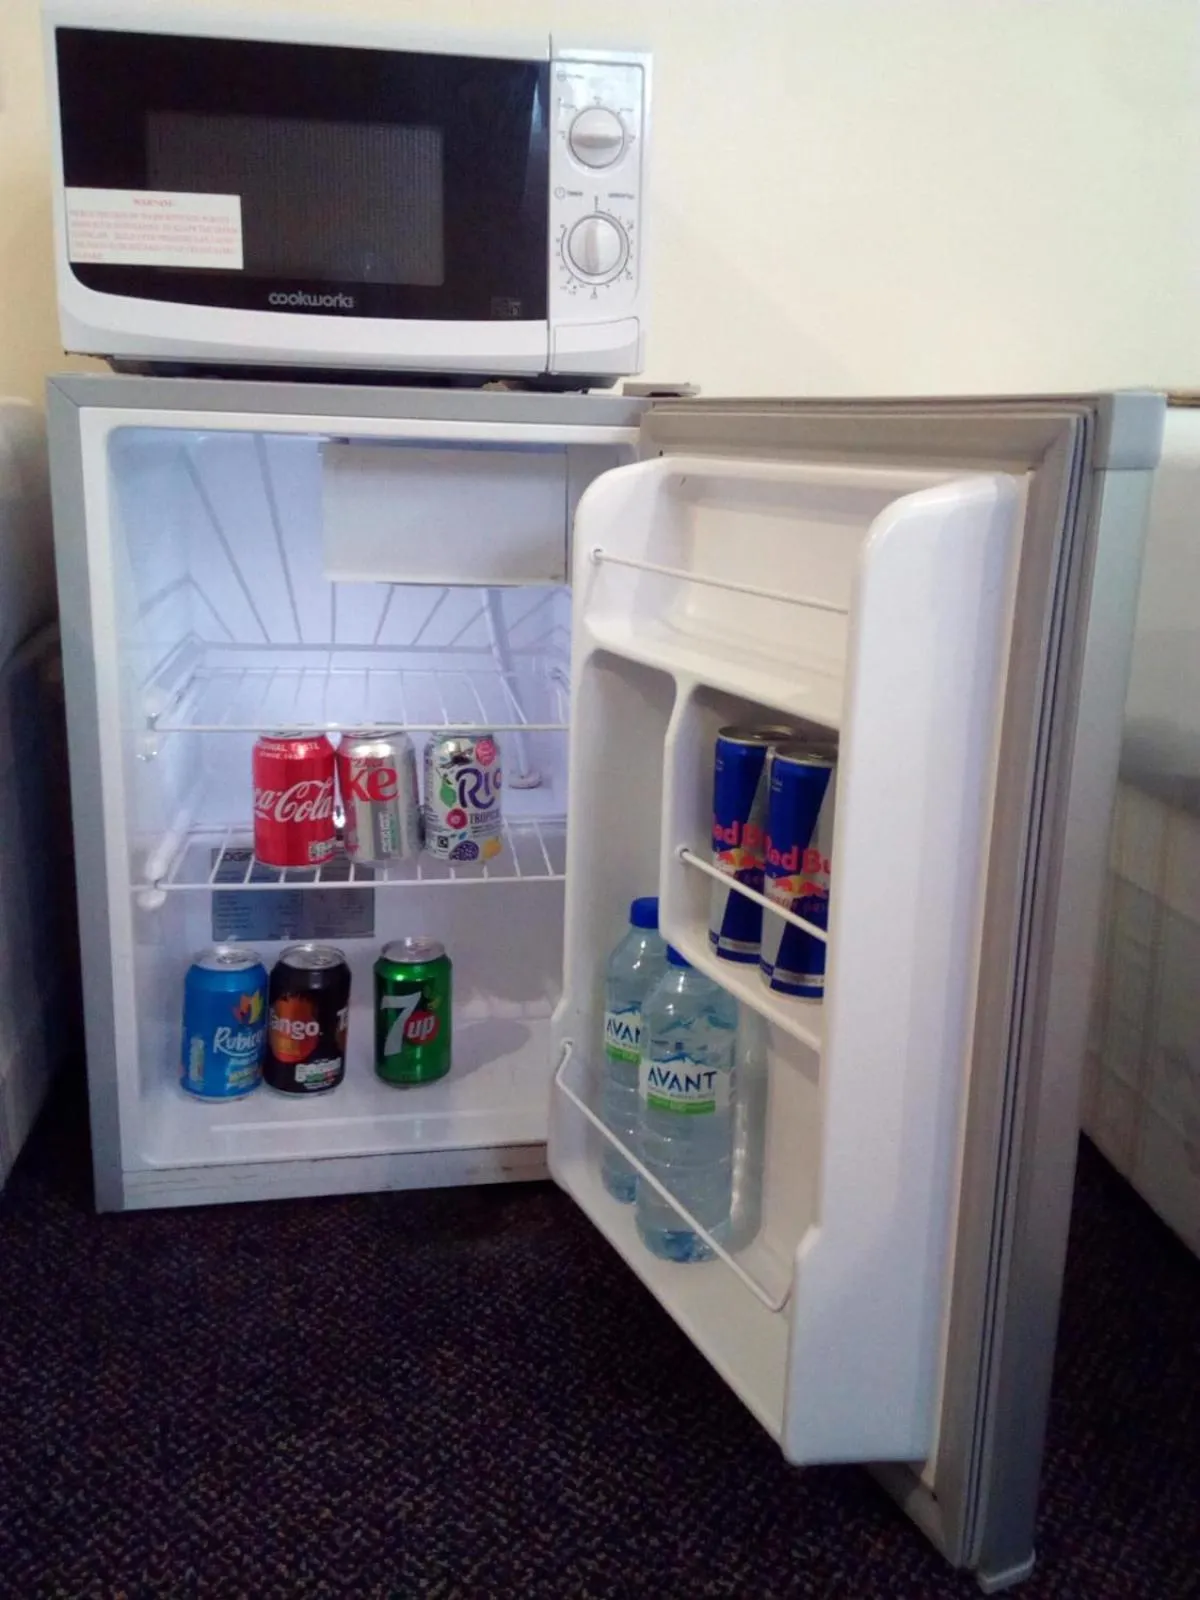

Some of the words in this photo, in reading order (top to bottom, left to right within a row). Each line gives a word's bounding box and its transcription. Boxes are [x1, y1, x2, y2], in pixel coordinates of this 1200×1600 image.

[254, 776, 333, 822] a-Cola
[347, 767, 398, 802] ke
[270, 1008, 319, 1040] ango
[606, 1017, 640, 1043] AVA
[648, 1067, 717, 1092] AVANT
